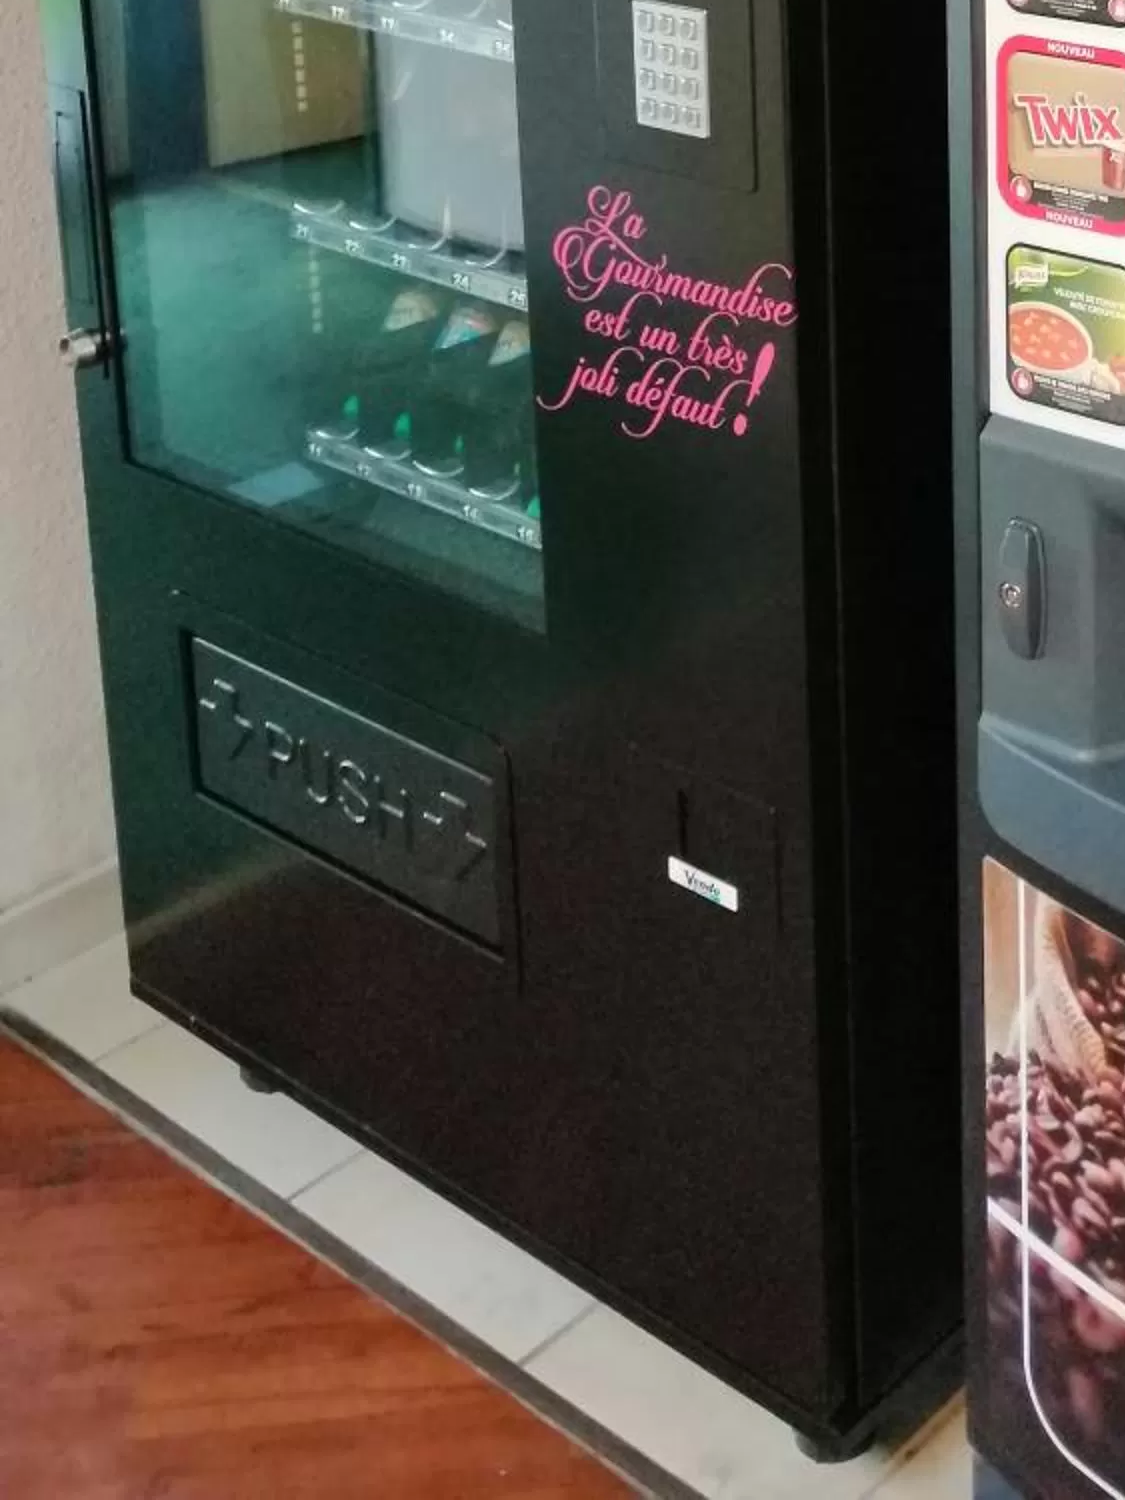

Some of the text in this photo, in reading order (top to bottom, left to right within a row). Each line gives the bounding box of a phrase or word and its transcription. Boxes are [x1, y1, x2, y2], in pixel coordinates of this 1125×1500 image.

[1047, 41, 1096, 60] NOUVEAU
[1045, 211, 1093, 229] NOUVEAU
[553, 226, 798, 327] Gourmandise
[584, 291, 748, 374] est un très
[536, 347, 644, 410] joli
[621, 358, 753, 438] défaut
[265, 720, 412, 848] PUSH
